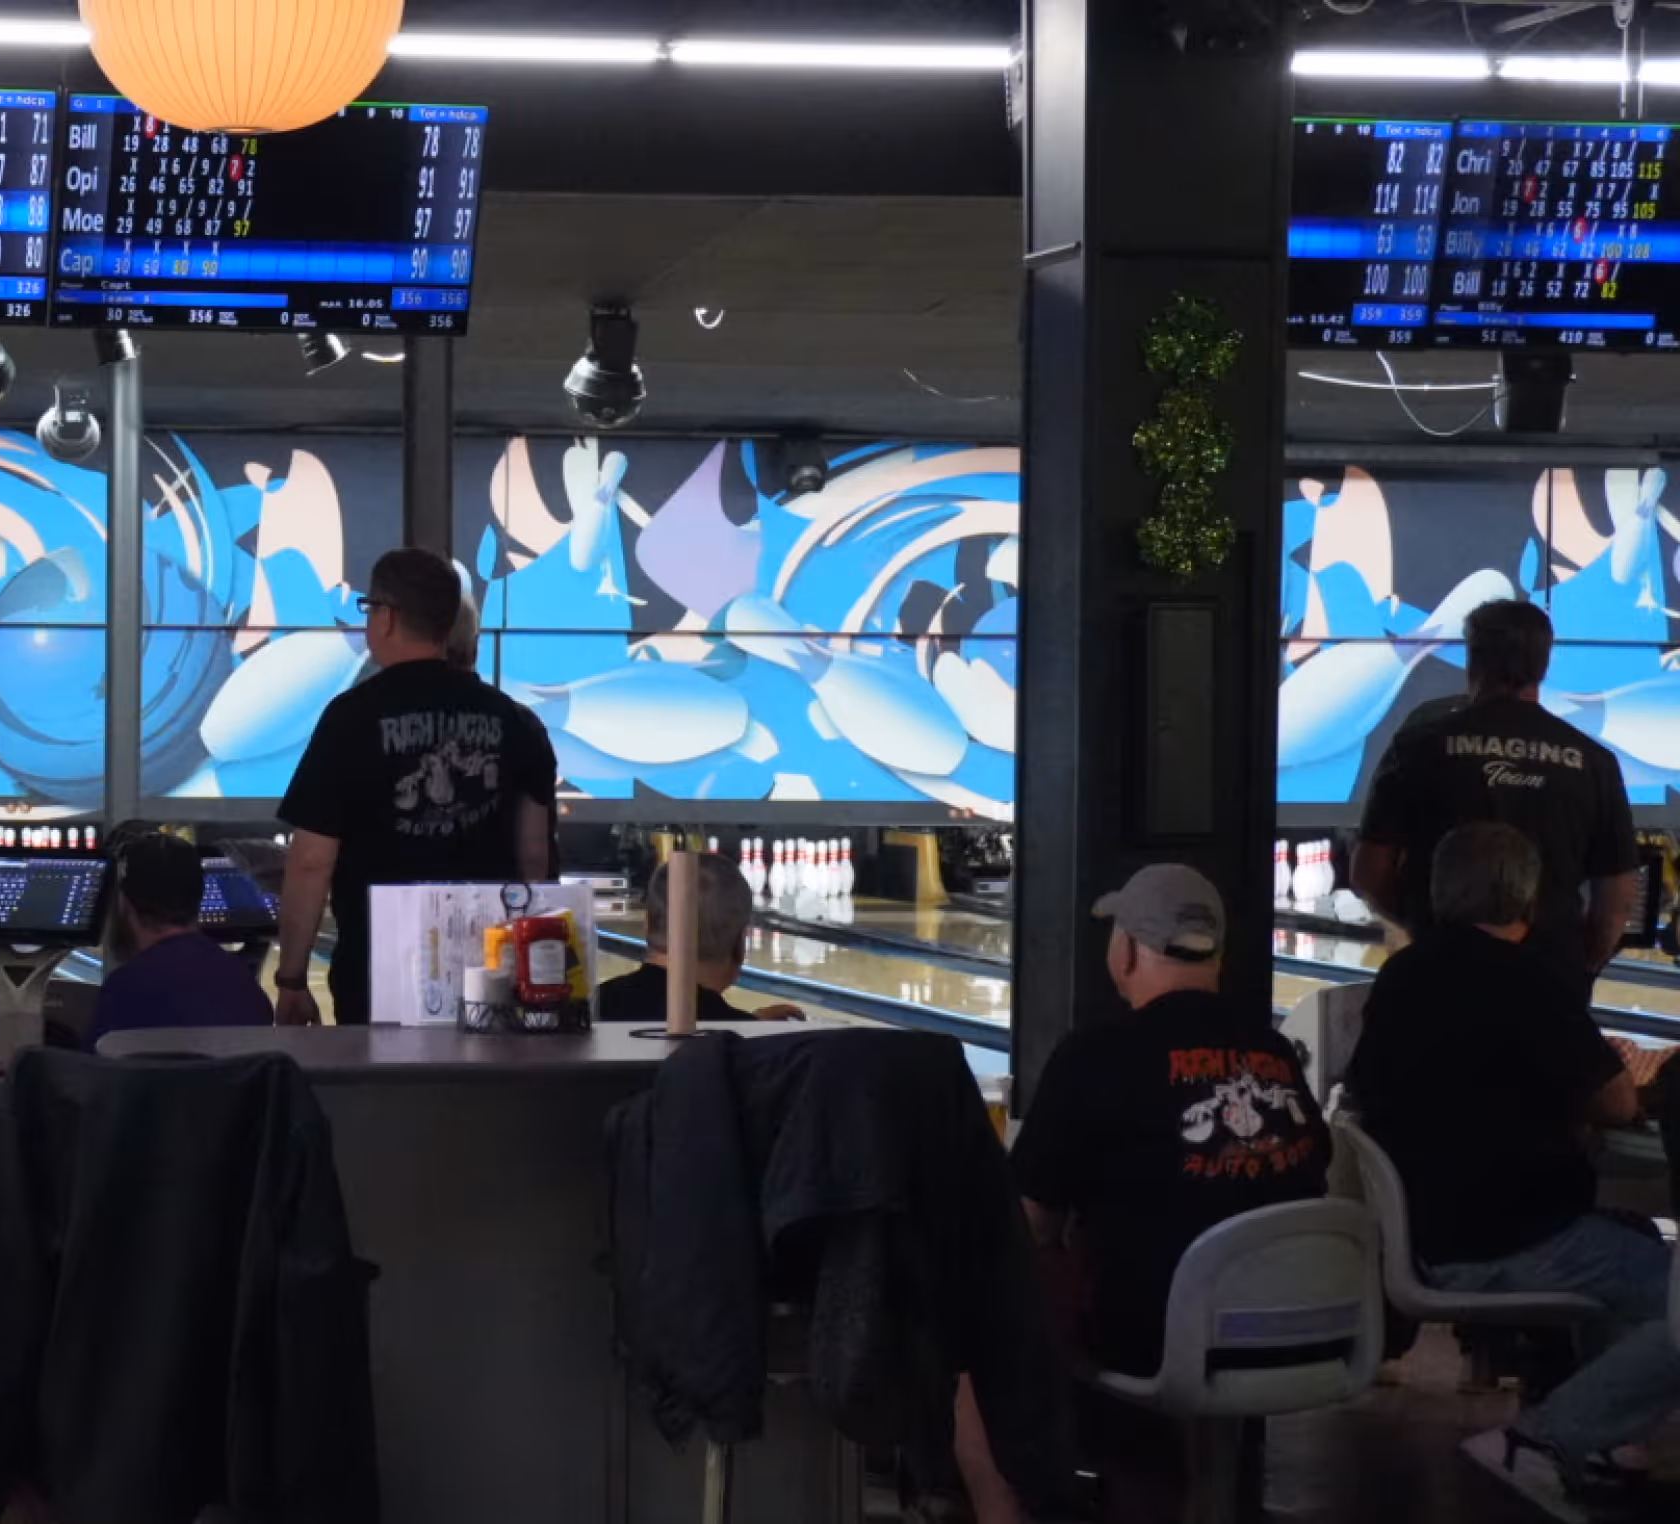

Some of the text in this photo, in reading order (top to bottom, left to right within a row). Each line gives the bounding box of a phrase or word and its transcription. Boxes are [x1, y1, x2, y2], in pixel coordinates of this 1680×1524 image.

[33, 113, 48, 144] 71
[69, 124, 97, 148] Bill
[123, 135, 138, 151] 19
[423, 126, 479, 158] 78 78
[30, 154, 47, 185] 87
[1387, 142, 1443, 174] 82 82
[1457, 150, 1491, 173] Chri
[1611, 163, 1662, 179] 105 115
[67, 167, 97, 195] Opi
[121, 177, 253, 196] 26 46 65 82 91
[419, 168, 474, 199] 91 91
[28, 195, 44, 226] 88
[1374, 183, 1439, 214] 114 114
[1451, 191, 1479, 215] Jon
[63, 208, 103, 231] Moe
[117, 218, 250, 237] 29 49 97
[415, 208, 471, 239] 97 97
[26, 237, 43, 268] 80
[61, 250, 93, 276] Cap
[411, 249, 428, 279] 90
[16, 282, 39, 294] 326
[1364, 265, 1427, 295] 100 100
[1453, 272, 1480, 295] Bill
[7, 304, 30, 316] 326
[400, 292, 422, 304] 356
[189, 310, 213, 322] 356
[430, 315, 453, 327] 356
[1447, 736, 1584, 769] IMAGING
[1483, 761, 1546, 787] Team
